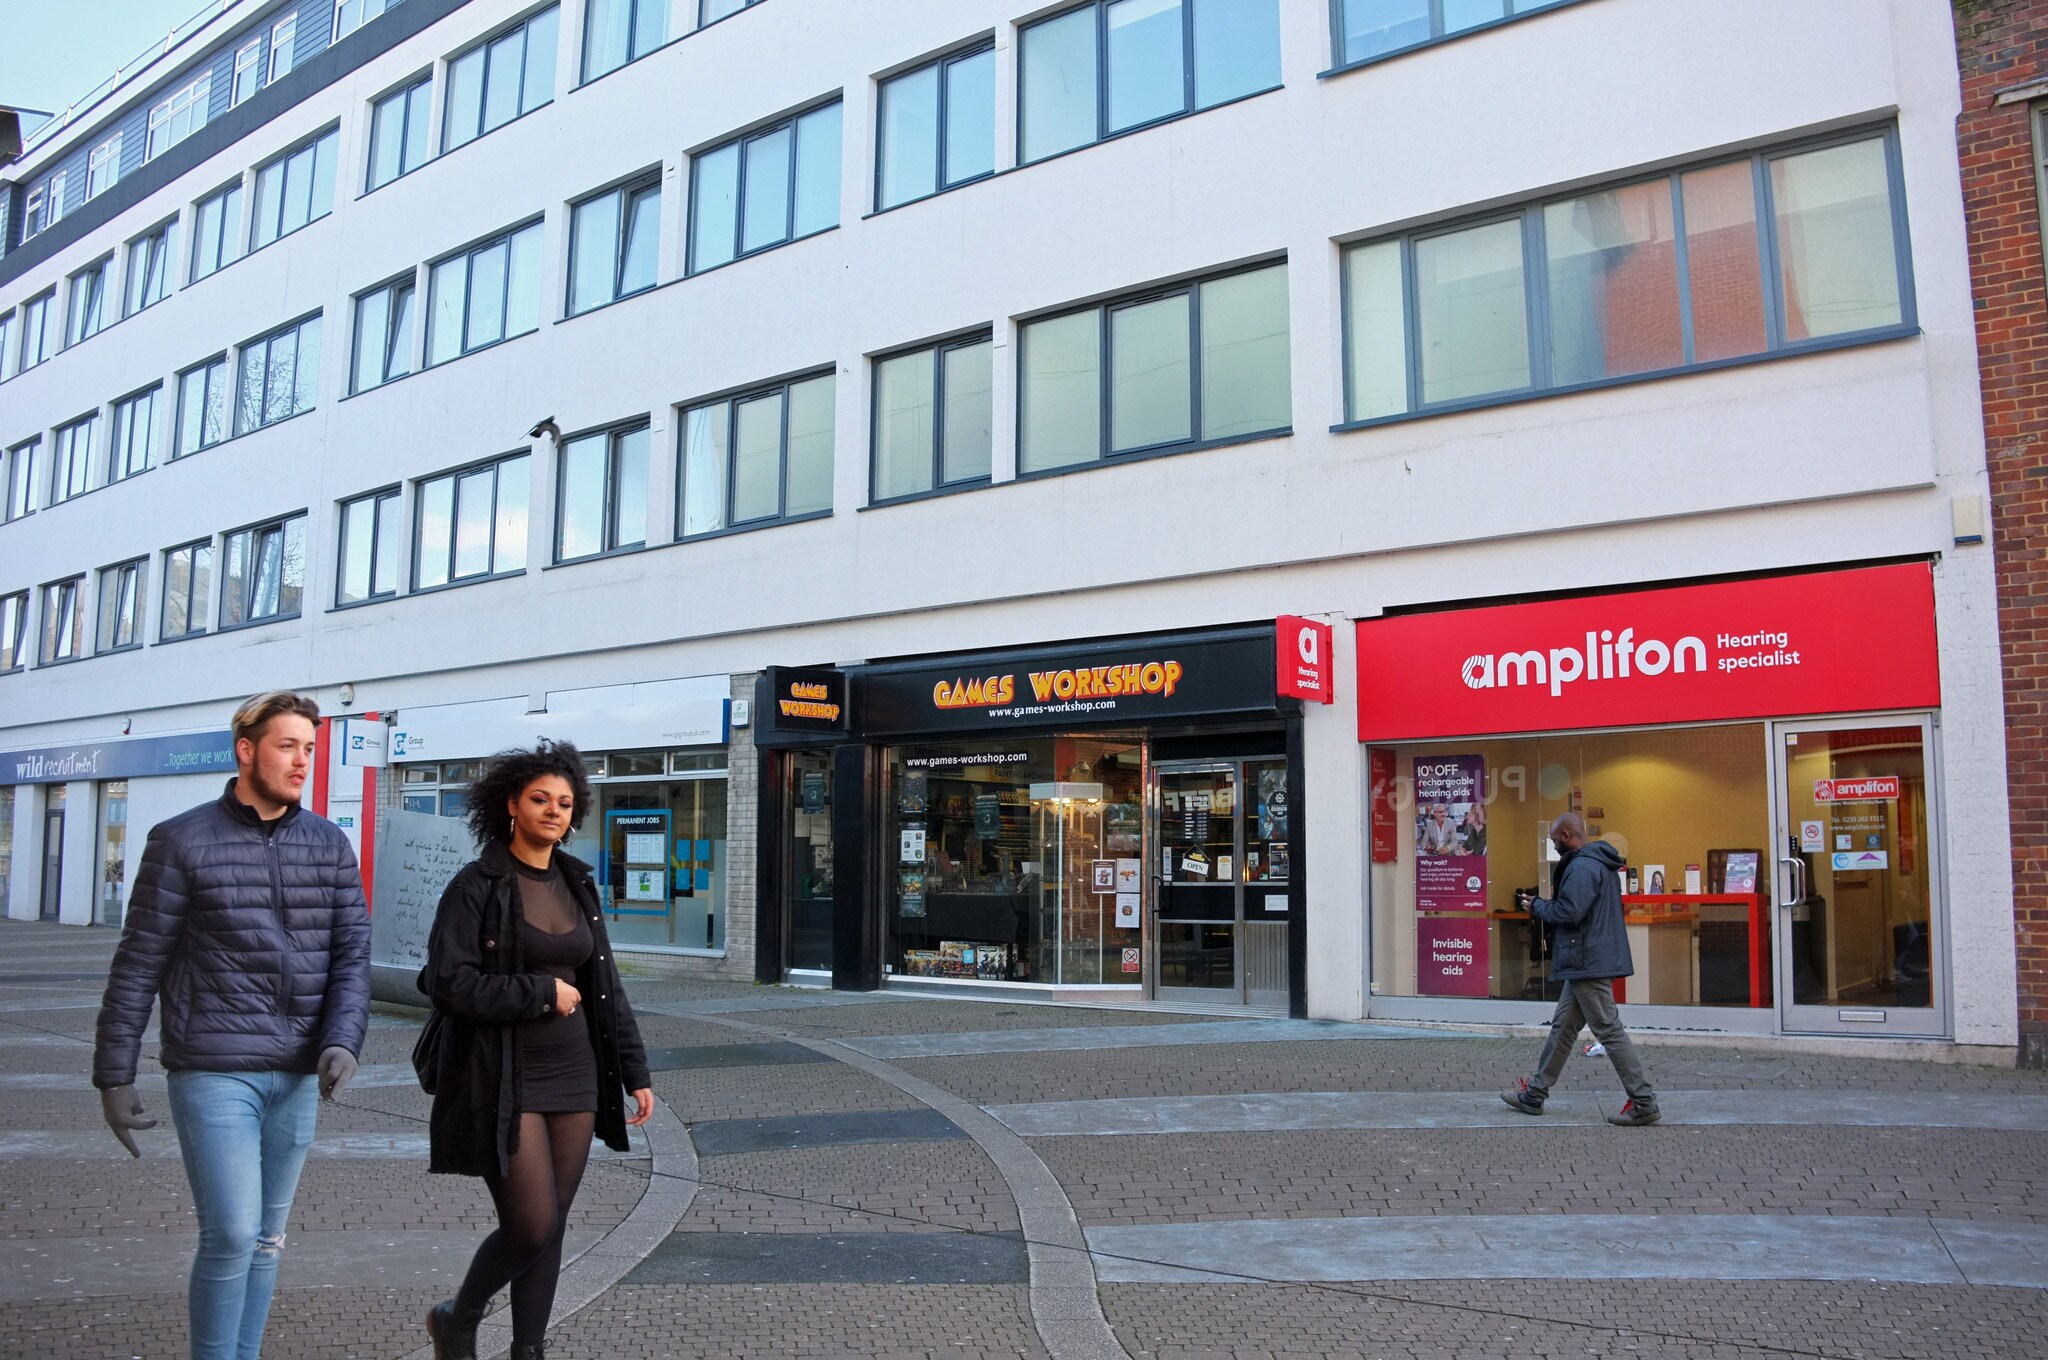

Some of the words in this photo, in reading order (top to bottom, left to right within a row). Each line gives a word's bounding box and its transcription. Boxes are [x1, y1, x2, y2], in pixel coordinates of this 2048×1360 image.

[1717, 629, 1788, 649] Hearing
[1461, 628, 1707, 697] amplifon
[1718, 650, 1801, 673] specialist
[1298, 666, 1318, 680] Hearing
[790, 681, 828, 700] GAMES
[933, 674, 1015, 710] GAMES
[1029, 660, 1182, 703] WORKSHOP
[1297, 679, 1320, 690] specialist
[779, 700, 840, 722] WORKSHOP
[989, 699, 1116, 718] www.games-workshop.com
[408, 736, 424, 747] Group
[201, 752, 212, 764] we
[214, 747, 233, 763] work
[906, 752, 1027, 768] www.games-workshop.com
[16, 755, 44, 779] wild
[44, 749, 101, 776] recruitment
[1434, 764, 1459, 776] OFF
[1418, 776, 1474, 787] rechargeable
[1836, 780, 1895, 797] amplifon
[1418, 788, 1451, 799] hearing
[616, 817, 647, 825] PERMANENT
[646, 816, 660, 824] JOBS
[1186, 862, 1204, 872] OPEN
[1420, 859, 1432, 867] Why
[1432, 938, 1473, 949] Invisible
[1432, 951, 1473, 965] hearing
[1442, 965, 1464, 976] aids
